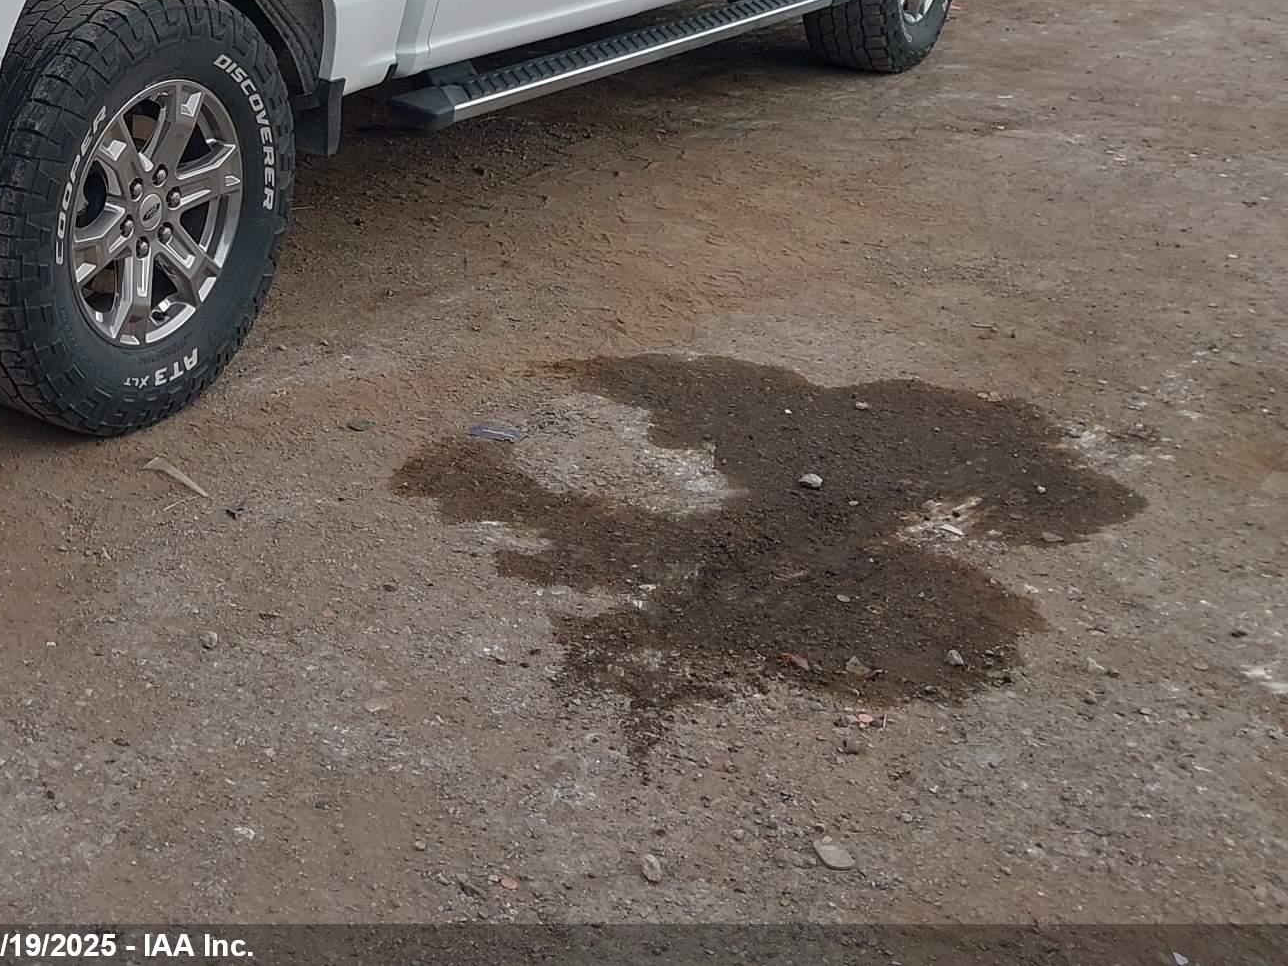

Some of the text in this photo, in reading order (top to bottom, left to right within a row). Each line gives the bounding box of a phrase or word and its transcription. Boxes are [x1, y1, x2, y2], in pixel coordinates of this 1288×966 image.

[213, 54, 275, 210] DISCOVERER
[55, 105, 107, 265] COOPER
[123, 375, 150, 389] XLT
[154, 347, 198, 386] AT3
